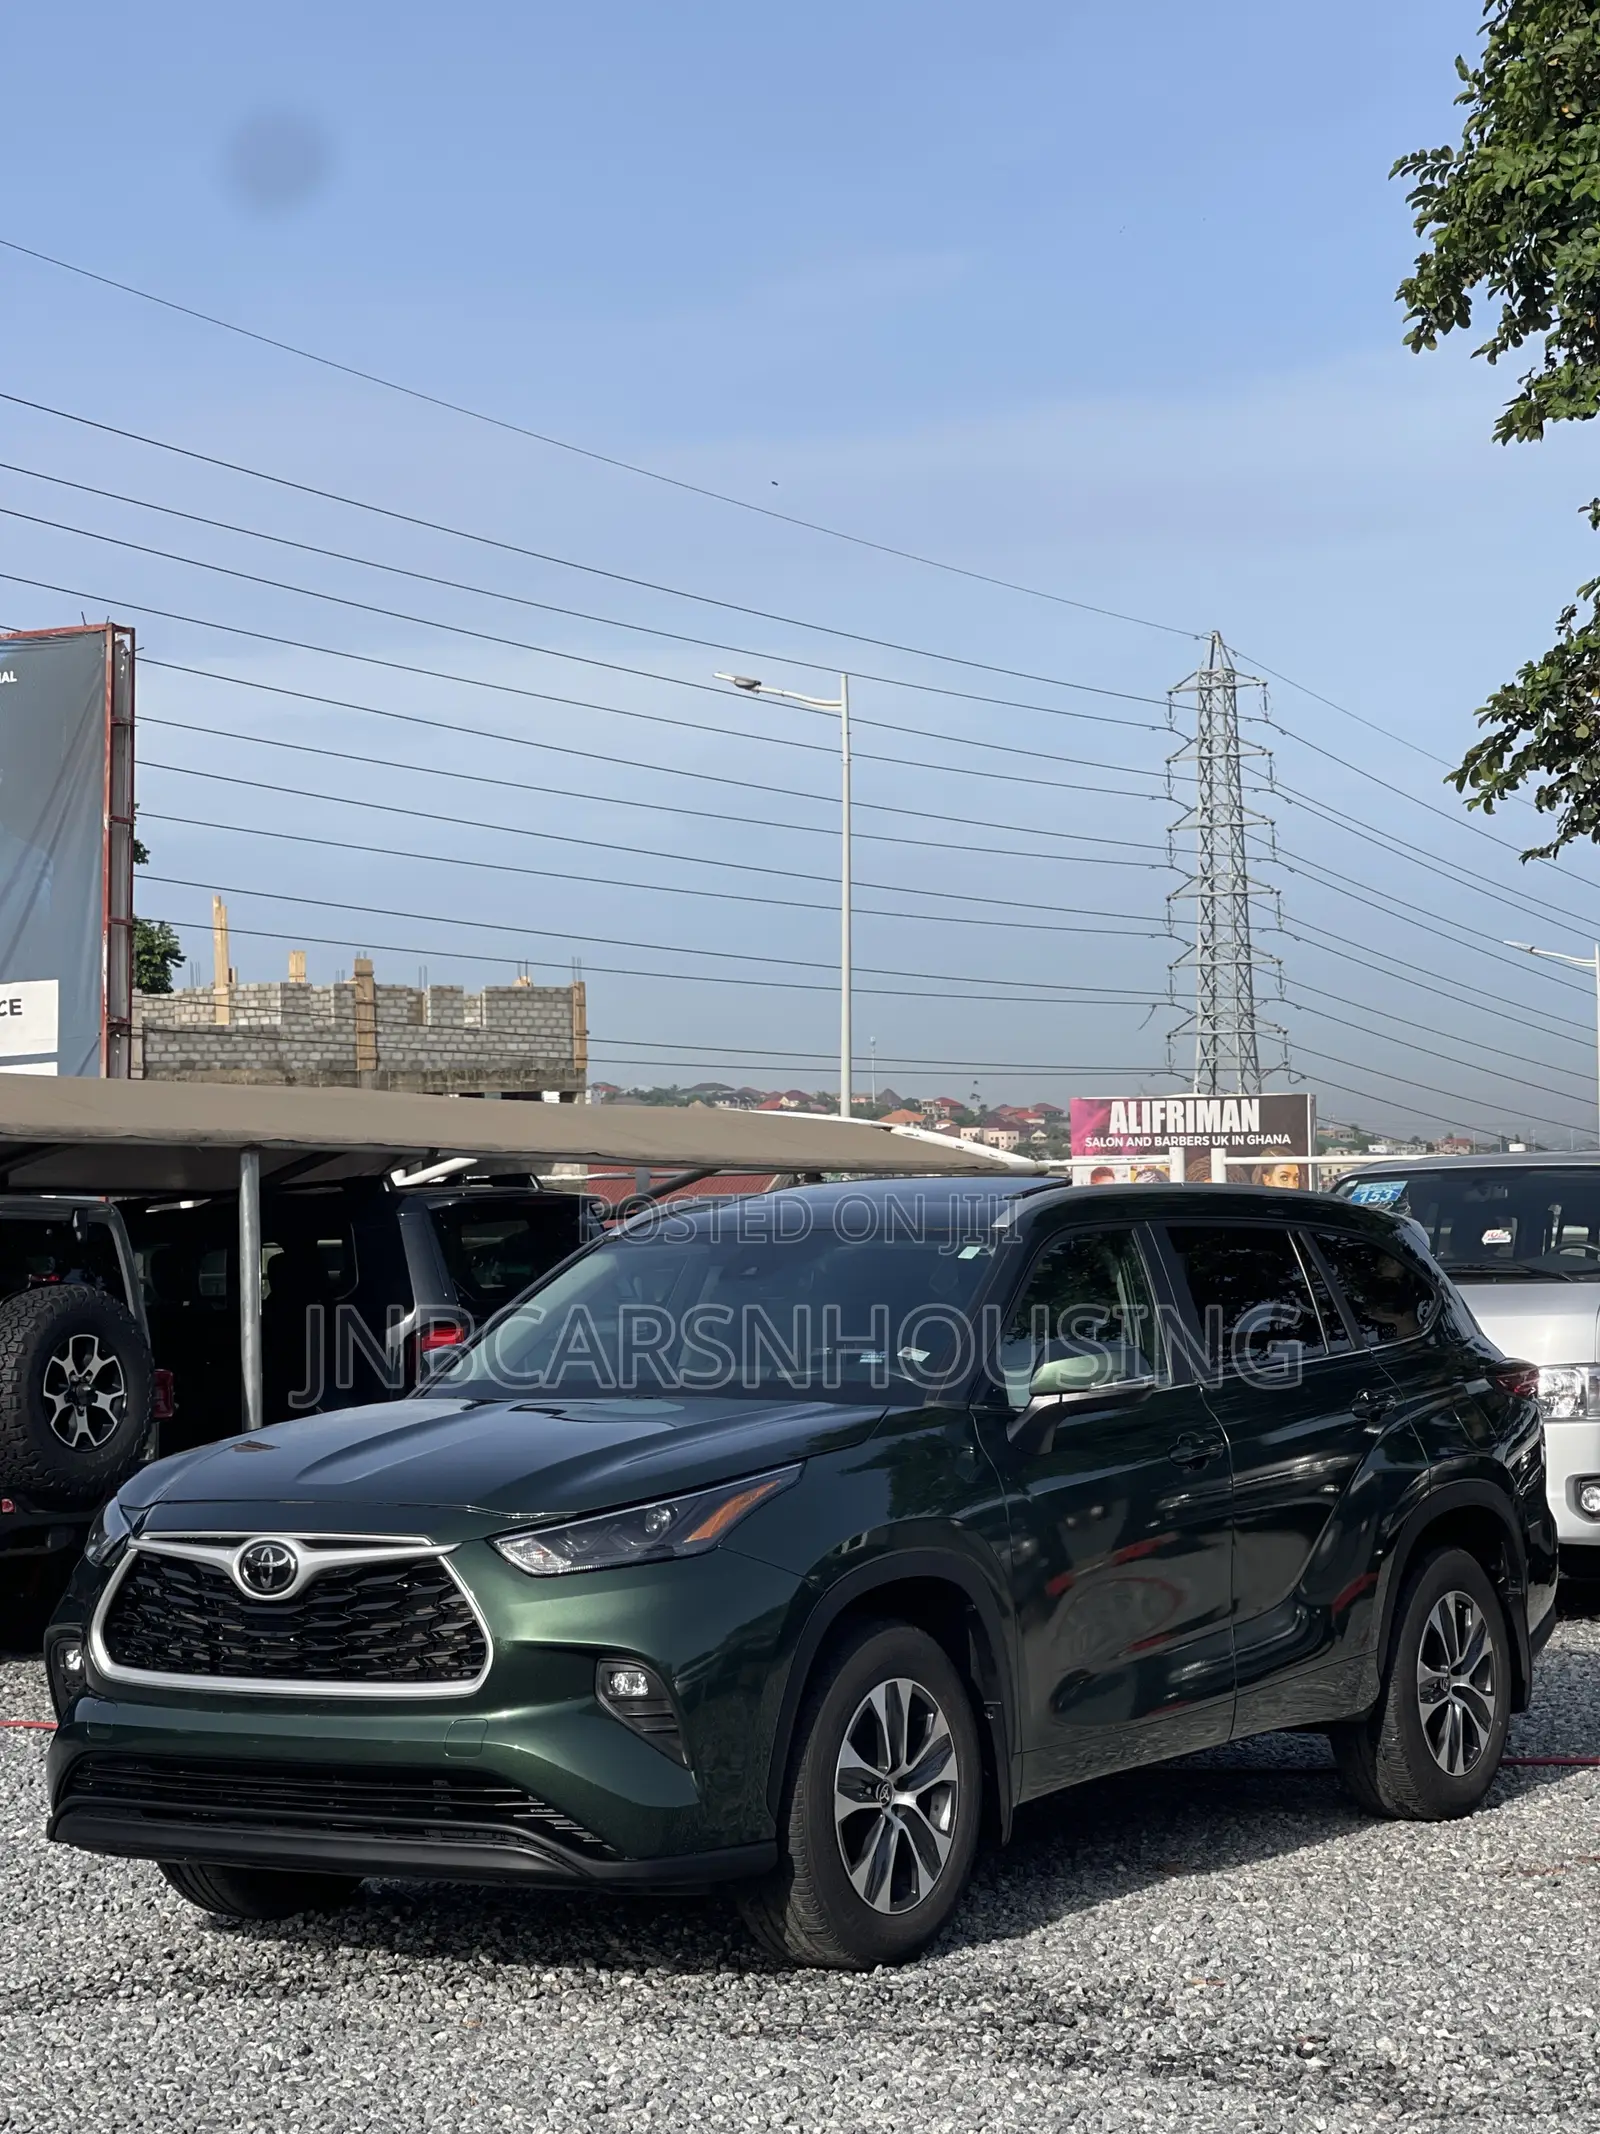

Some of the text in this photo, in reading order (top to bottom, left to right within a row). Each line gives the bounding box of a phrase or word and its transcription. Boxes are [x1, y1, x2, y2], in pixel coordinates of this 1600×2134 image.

[1109, 1099, 1260, 1134] ALIFRIMAN
[1085, 1133, 1292, 1148] SALON AND BARBERS UK IN GHANA
[1360, 1190, 1393, 1203] 153
